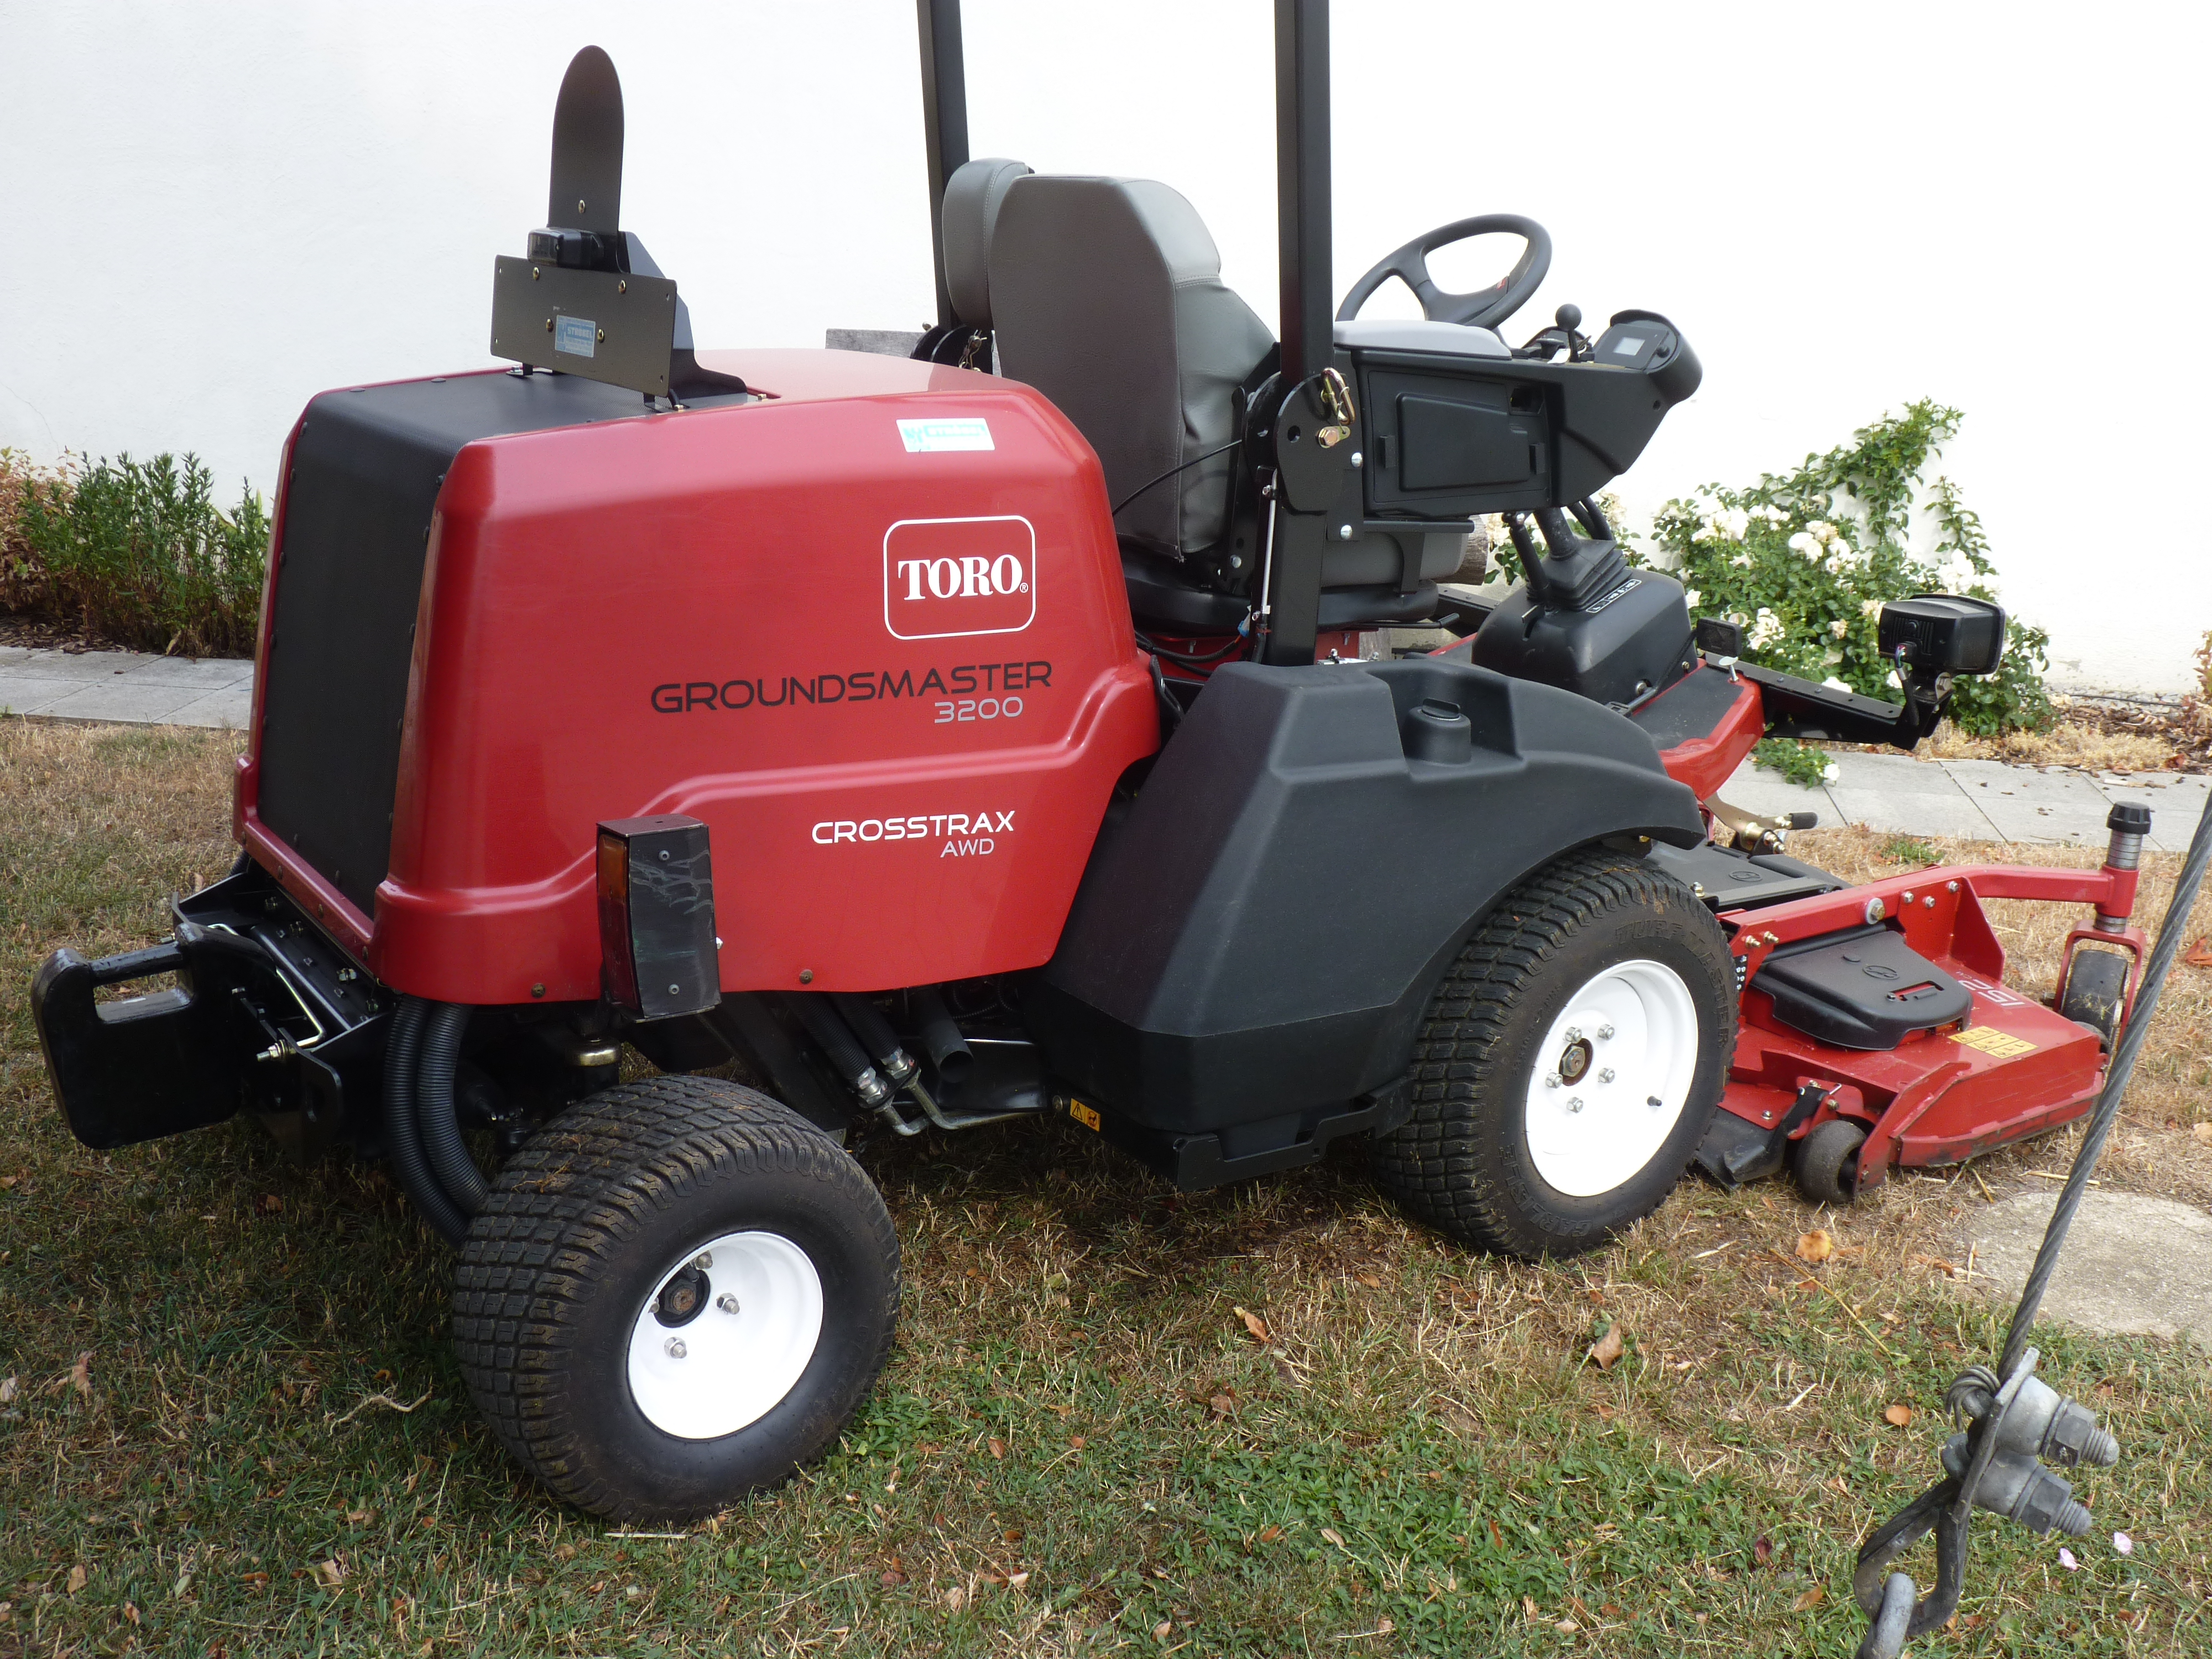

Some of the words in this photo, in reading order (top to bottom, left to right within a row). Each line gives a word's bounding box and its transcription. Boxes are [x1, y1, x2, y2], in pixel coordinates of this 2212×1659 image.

[651, 661, 1052, 713] GROUNDSMASTER
[935, 696, 1023, 723] 3200
[812, 811, 1015, 844] CROSSTRAX
[940, 838, 995, 858] AWD
[1958, 979, 2026, 1006] 152
